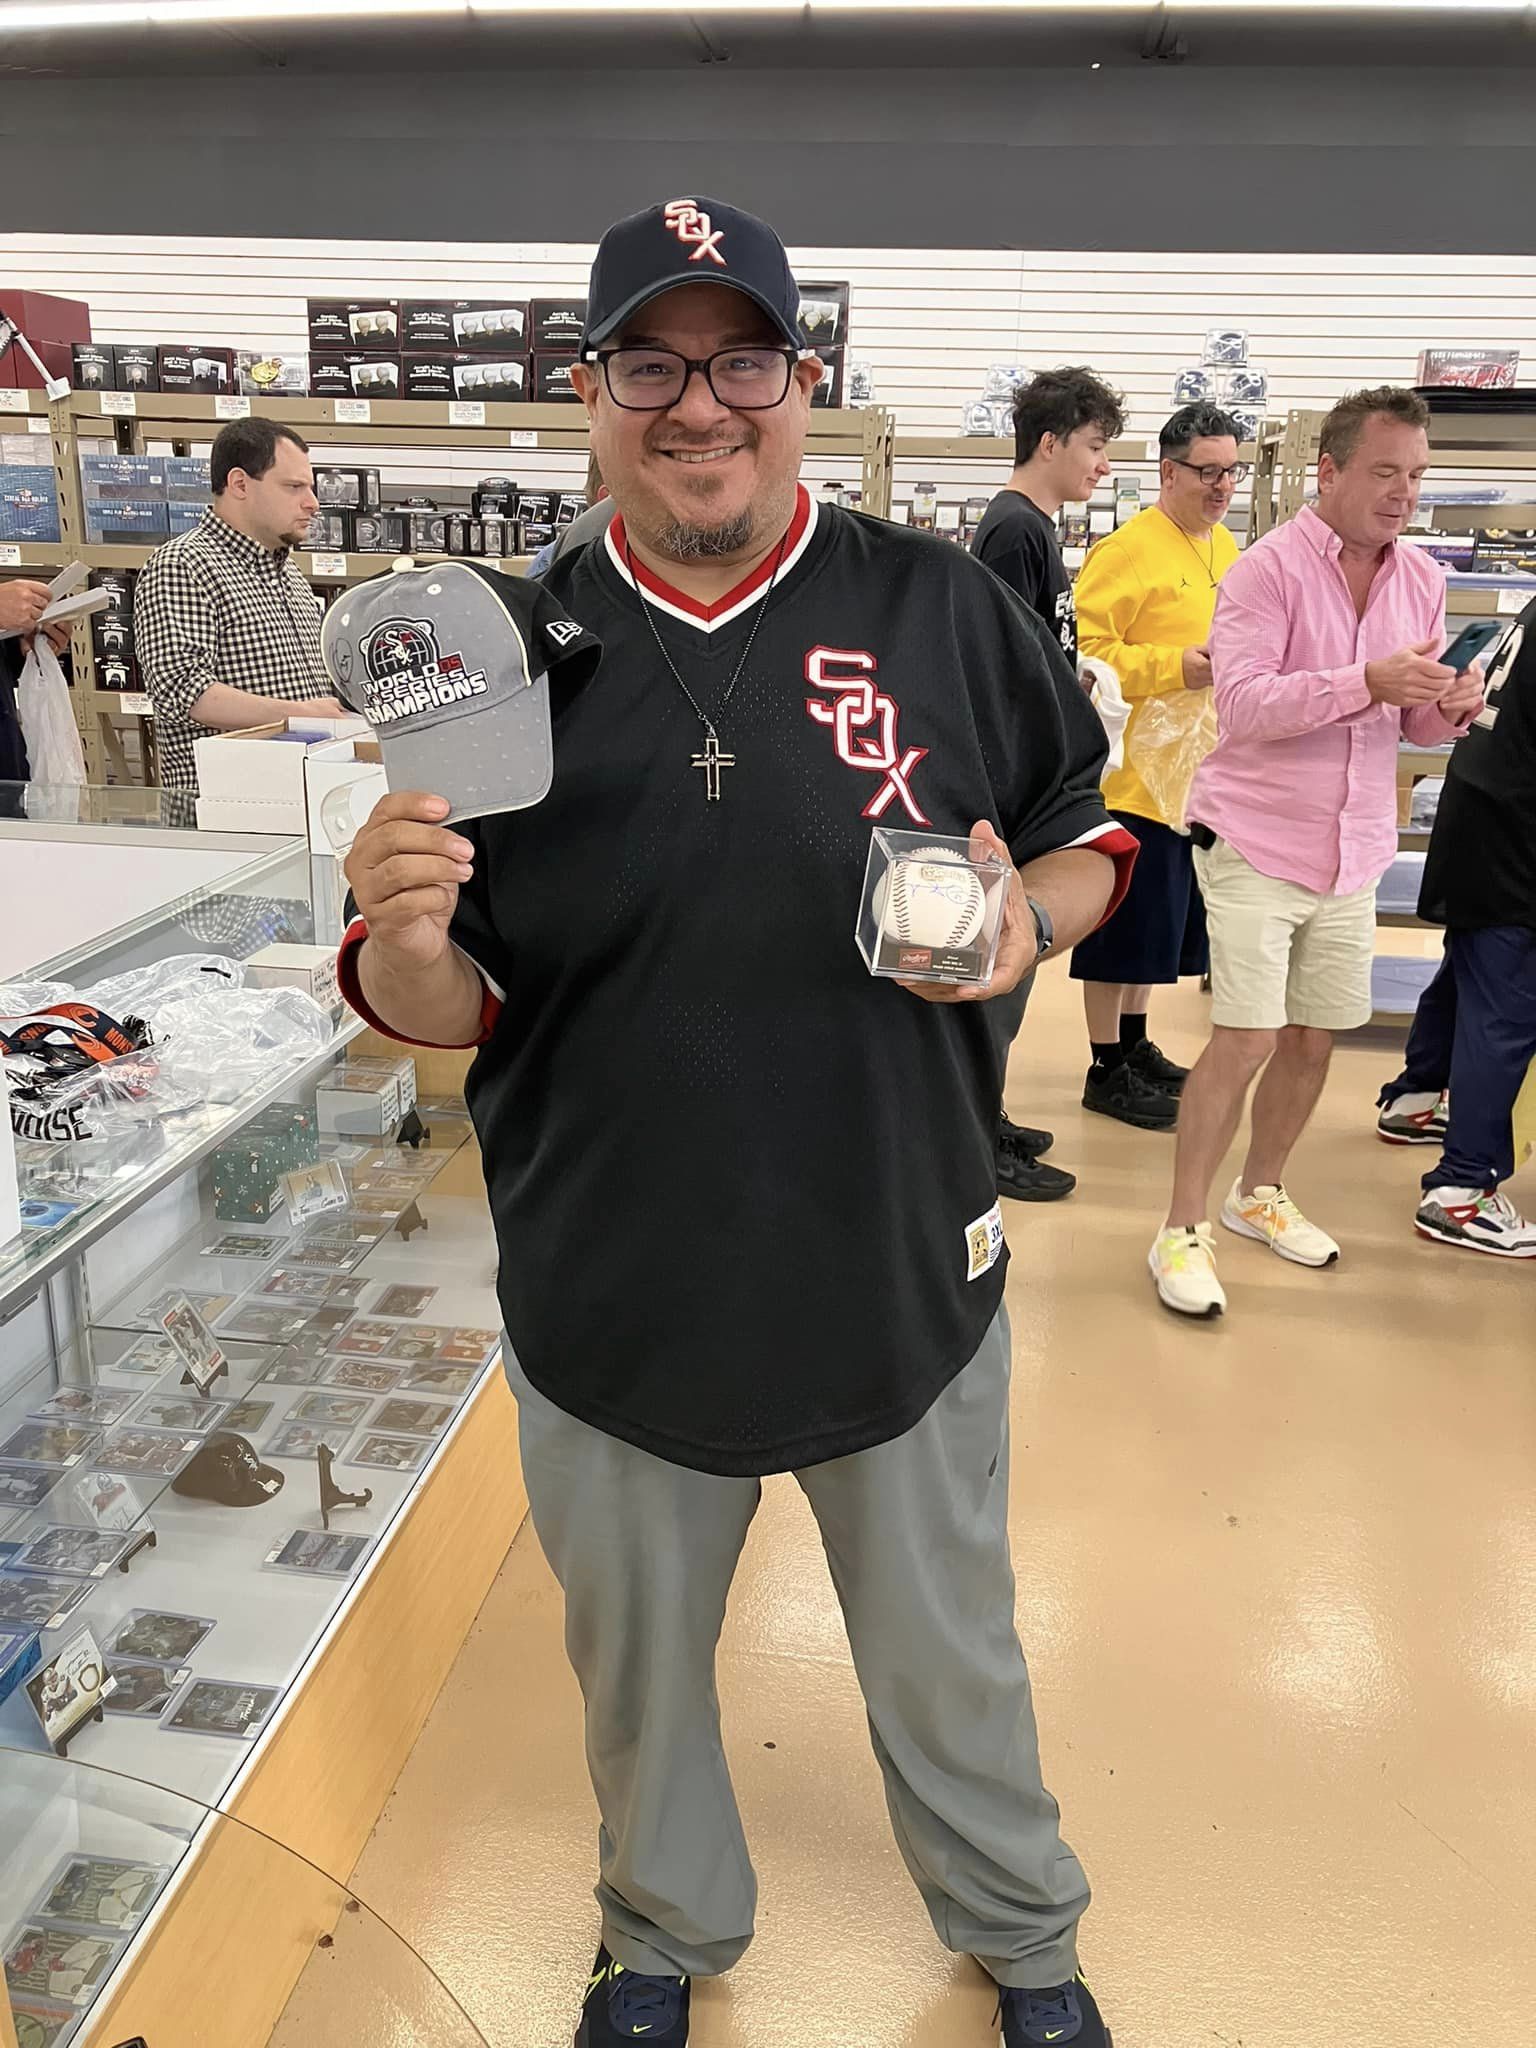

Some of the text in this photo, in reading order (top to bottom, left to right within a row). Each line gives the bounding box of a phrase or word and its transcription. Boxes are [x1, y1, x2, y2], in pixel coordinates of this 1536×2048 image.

[664, 199, 728, 268] SOX
[361, 662, 440, 696] WORLD
[363, 673, 488, 726] CHAMPIONS
[380, 668, 466, 704] SERIES
[804, 645, 933, 827] SOX
